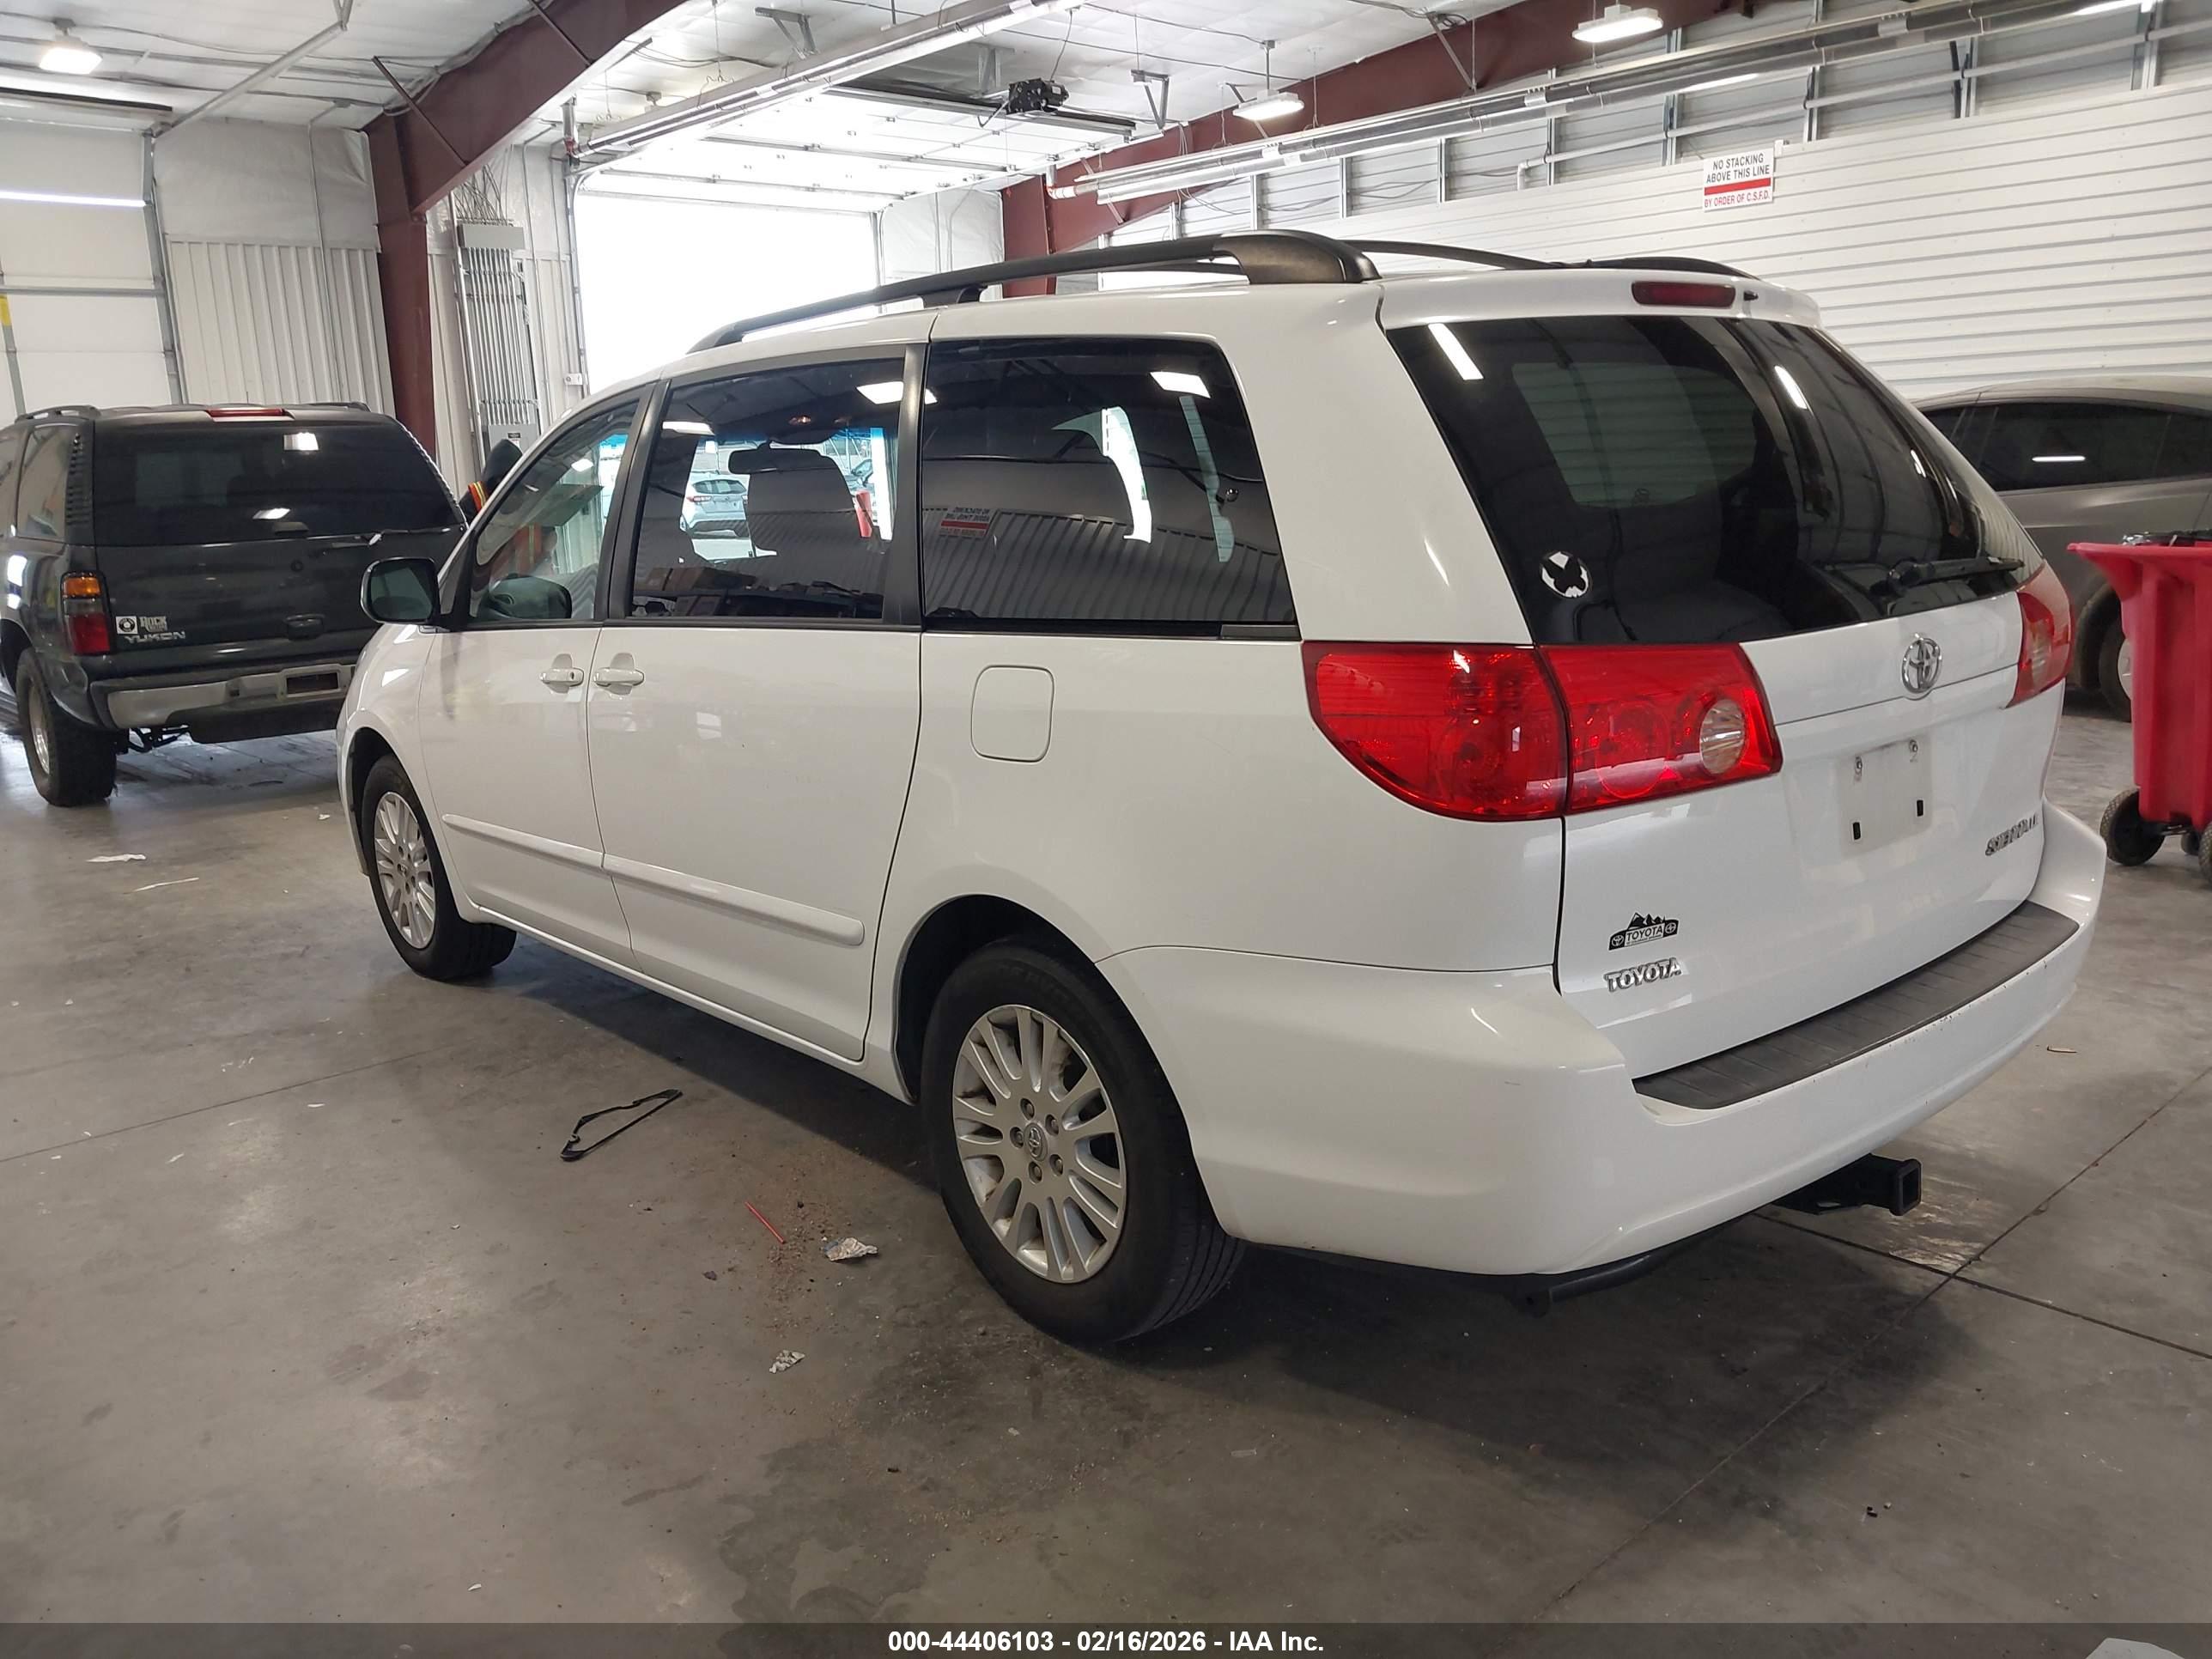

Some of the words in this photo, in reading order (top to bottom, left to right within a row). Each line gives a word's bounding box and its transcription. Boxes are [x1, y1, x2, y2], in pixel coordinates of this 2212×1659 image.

[1713, 160, 1723, 170] NO
[1726, 153, 1764, 168] STACKING
[1706, 170, 1731, 183] ABOVE
[1734, 167, 1750, 179] THIS
[1753, 165, 1770, 176] LINE
[1705, 198, 1712, 208] BY
[1714, 195, 1735, 206] ORDER
[1736, 193, 1745, 204] OF
[124, 630, 185, 643] YUKON
[1626, 926, 1663, 941] TOYOTA
[1603, 957, 1682, 992] TOYOTA
